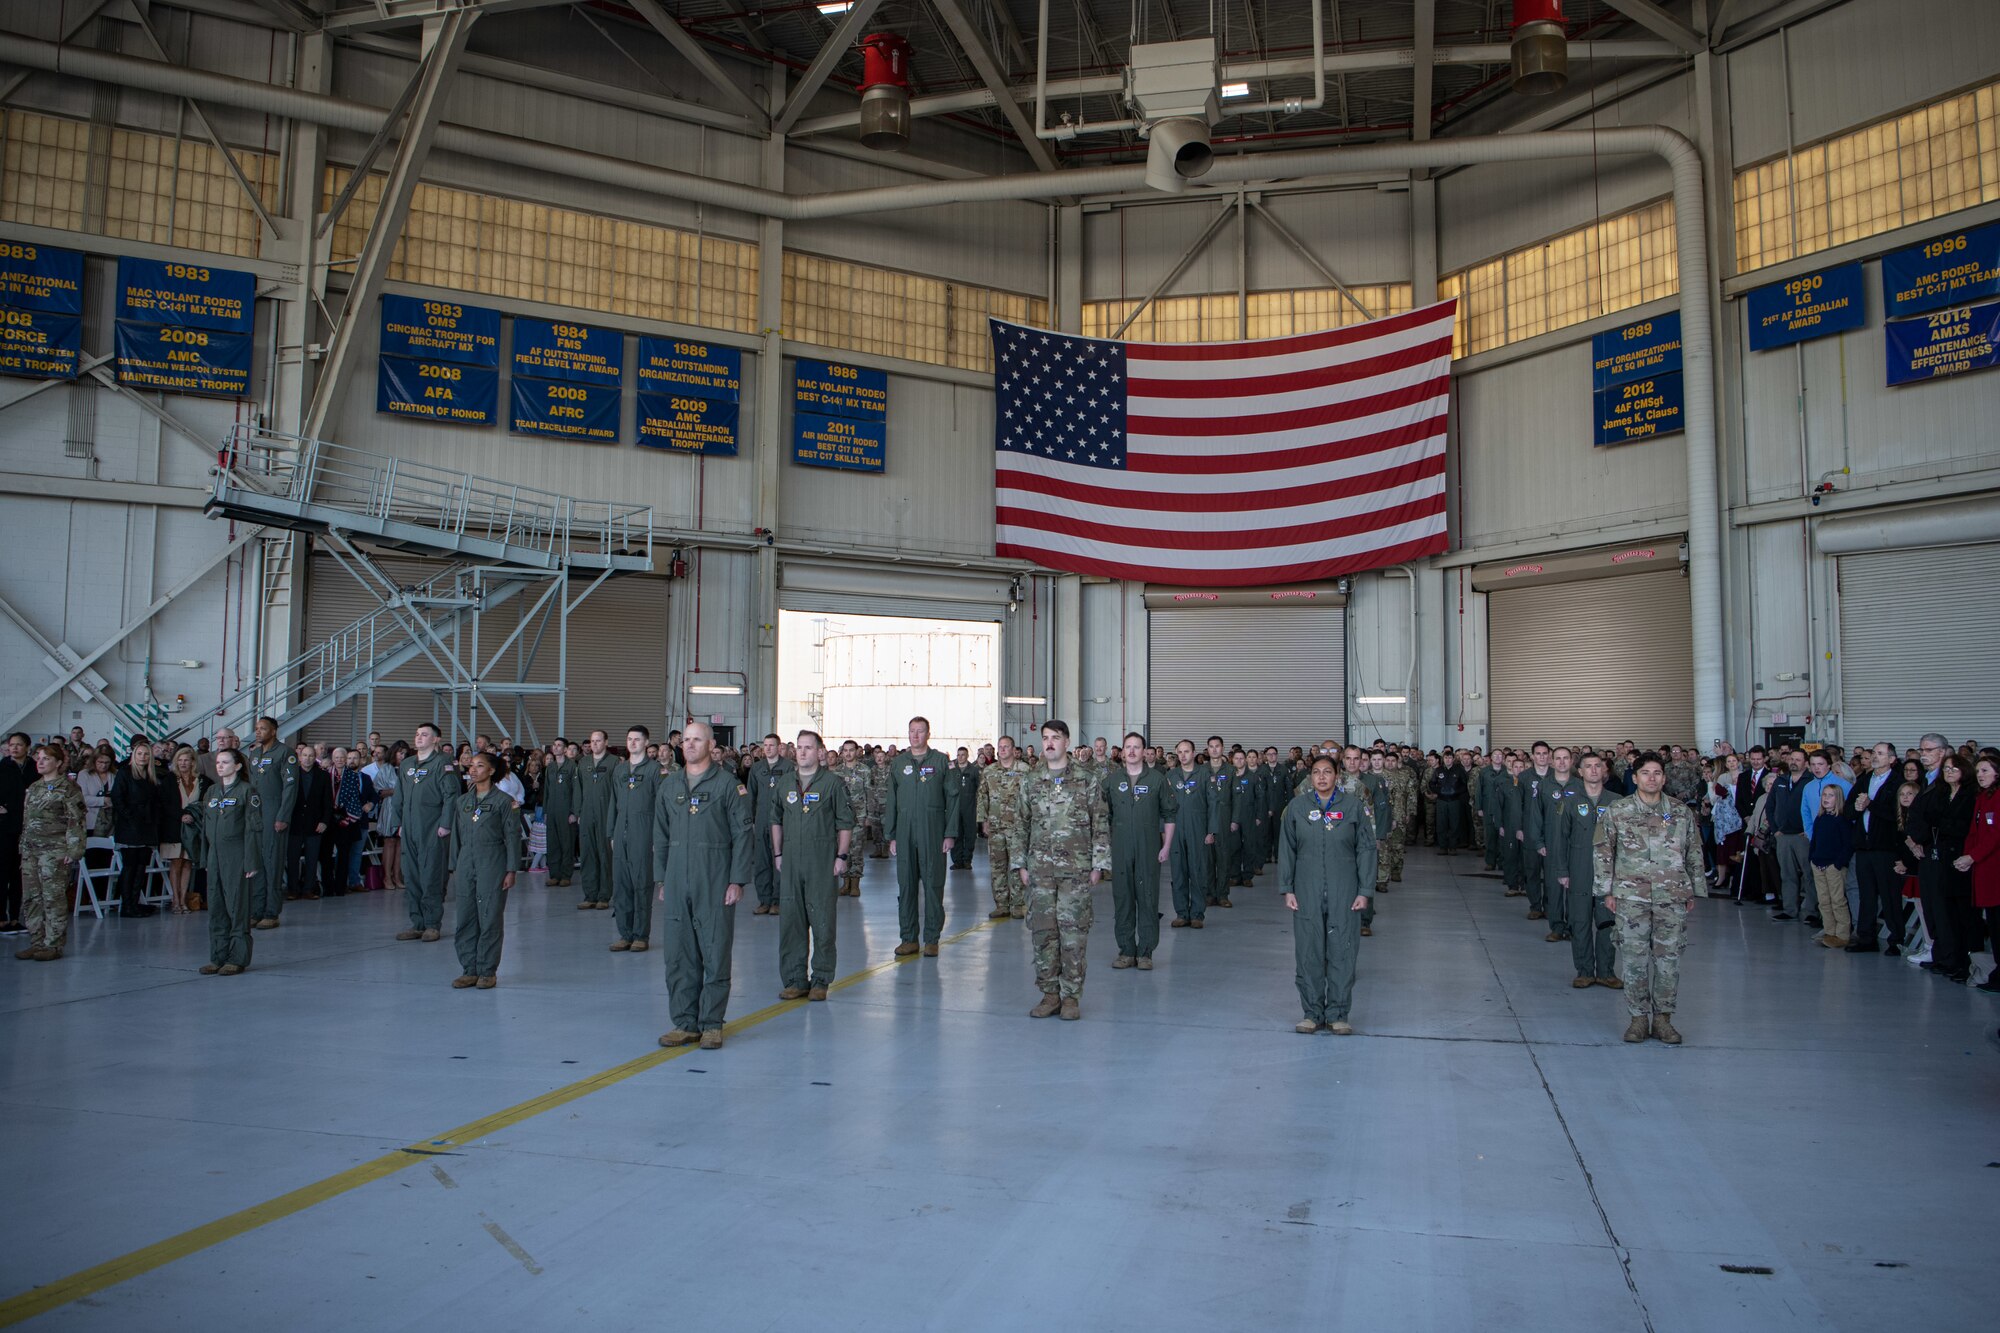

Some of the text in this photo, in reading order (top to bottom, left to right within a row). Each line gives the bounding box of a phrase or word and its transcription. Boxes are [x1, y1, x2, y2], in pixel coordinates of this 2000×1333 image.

[0, 244, 37, 261] 983
[1924, 235, 1967, 260] 1996
[1, 271, 78, 290] ANIZATIONAL
[165, 264, 210, 282] 1983
[1916, 261, 1980, 287] AMC RODEO
[9, 283, 21, 293] IN
[25, 285, 50, 298] MAC
[1784, 275, 1823, 296] 1990
[1896, 267, 2000, 302] BEST C-17 MX TEAM
[127, 287, 241, 309] MAC VOLANT RODEO
[1795, 292, 1811, 306] LG
[127, 297, 241, 319] BEST C-141 MX TEAM
[423, 302, 463, 319] 1983
[1781, 310, 1793, 321] AF
[1795, 297, 1849, 319] DAEDALIAN
[0, 310, 33, 327] 008
[428, 316, 457, 329] OMS
[1788, 315, 1822, 331] AWARD
[1928, 307, 1971, 328] 2014
[0, 328, 47, 343] ORCE
[160, 329, 208, 346] 2008
[387, 323, 495, 346] CINCMAC TROPHY FOR
[552, 324, 588, 340] 1984
[1622, 322, 1652, 341] 1989
[1931, 323, 1970, 341] AMXS
[0, 342, 75, 358] EAPON SYSTEM
[408, 336, 474, 352] AIRCRAFT MX
[557, 338, 582, 349] FMS
[674, 342, 708, 358] 1986
[1914, 333, 1987, 358] MAINTENANCE
[167, 350, 200, 363] AMC
[530, 347, 606, 365] AF OUTSTANDING
[1596, 340, 1681, 369] BEST ORGANIZATIONAL
[1911, 344, 1992, 369] EFFECTIVENESS
[24, 359, 72, 373] TROPHY
[118, 358, 247, 377] DAEDALIAN WEAPON SYSTEM
[419, 364, 461, 381] 2008
[516, 354, 619, 376] FIELD LEVEL MX AWARD
[651, 357, 729, 375] MAC OUTSTANDING
[827, 365, 858, 380] 1986
[1611, 354, 1664, 374] MX SQ IN MAC
[1933, 361, 1970, 376] AWARD
[119, 372, 245, 391] MAINTENANCE TROPHY
[639, 368, 739, 390] ORGANIZATIONAL MX SQ
[424, 386, 453, 400] AFA
[548, 385, 587, 401] 2008
[797, 379, 886, 400] MAC VOLANT RODEO
[1623, 381, 1654, 399] 2012
[671, 398, 707, 413] 2009
[797, 391, 885, 412] BEST C-141 MX TEAM
[1615, 396, 1664, 414] 4AF CMSgt
[389, 401, 486, 420] CITATION OF HONOR
[549, 405, 585, 419] AFRC
[676, 412, 700, 423] AMC
[1603, 406, 1678, 430] James K. Clause
[515, 419, 615, 438] TEAM EXCELLENCE AWARD
[641, 426, 734, 444] SYSTEM MAINTENANCE
[646, 418, 729, 435] DAEDALIAN WEAPON
[827, 422, 855, 435] 2011
[1624, 423, 1656, 436] Trophy
[671, 439, 704, 450] TROPHY
[803, 431, 878, 448] AIR MOBILITY RODEO
[817, 442, 864, 455] BEST C17 MX
[798, 449, 881, 466] BEST C17 SKILLS TEAM
